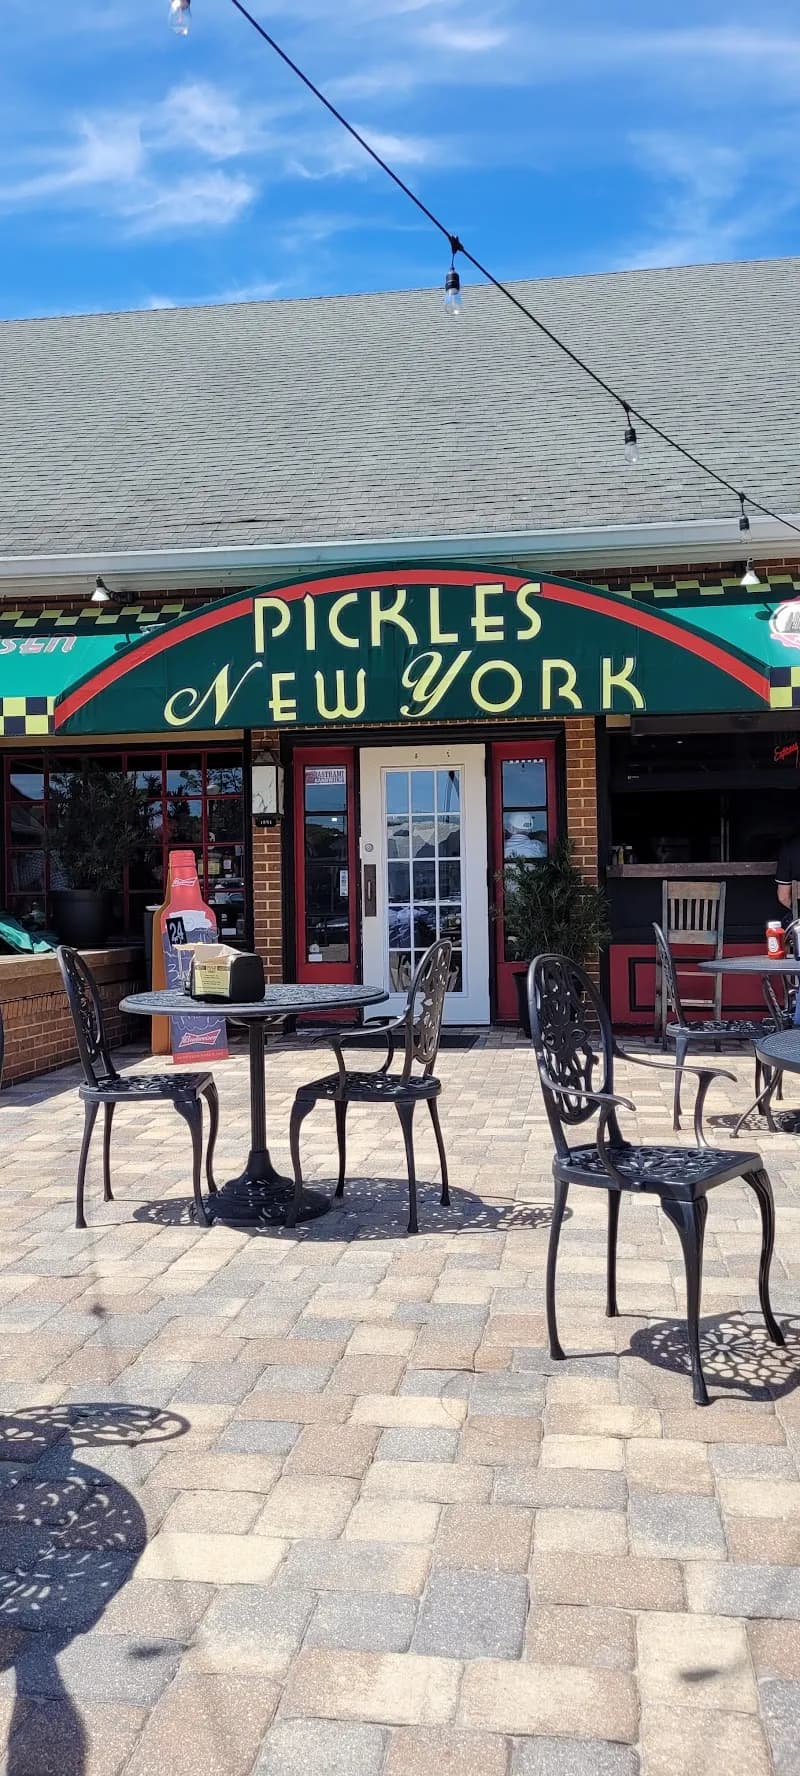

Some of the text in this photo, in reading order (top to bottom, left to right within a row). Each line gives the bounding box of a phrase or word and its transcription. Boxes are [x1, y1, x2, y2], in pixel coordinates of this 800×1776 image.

[254, 583, 541, 653] PICKLES
[163, 651, 645, 726] NEW YORK
